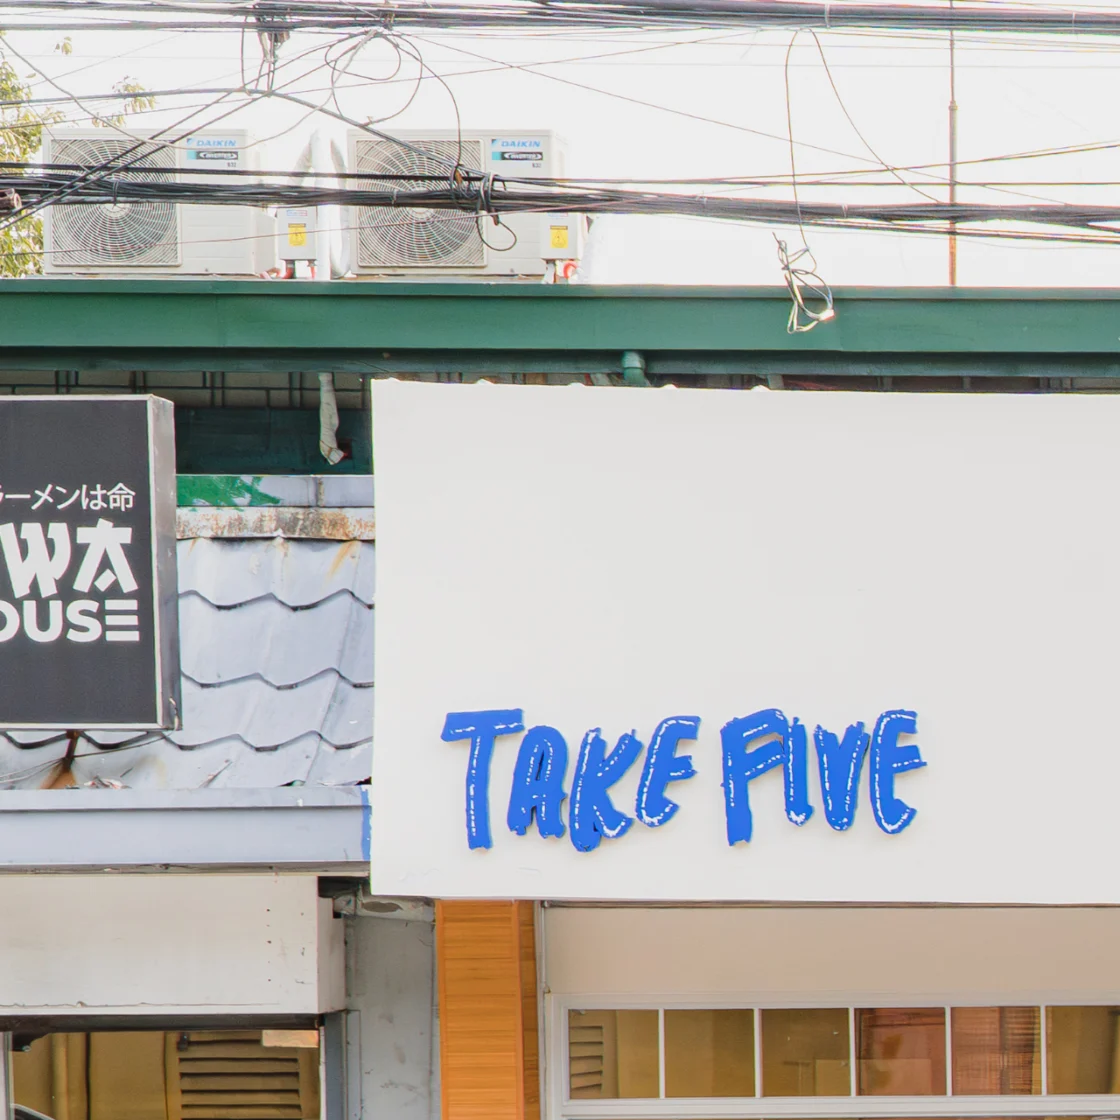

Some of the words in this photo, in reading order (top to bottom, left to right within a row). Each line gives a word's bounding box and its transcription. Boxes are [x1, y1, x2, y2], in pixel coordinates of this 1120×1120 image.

[196, 139, 237, 147] DAIKIN
[501, 140, 541, 148] DAIKIN
[0, 483, 135, 511] ーメンは命
[441, 708, 701, 852] TAKE
[720, 708, 927, 847] FIVE
